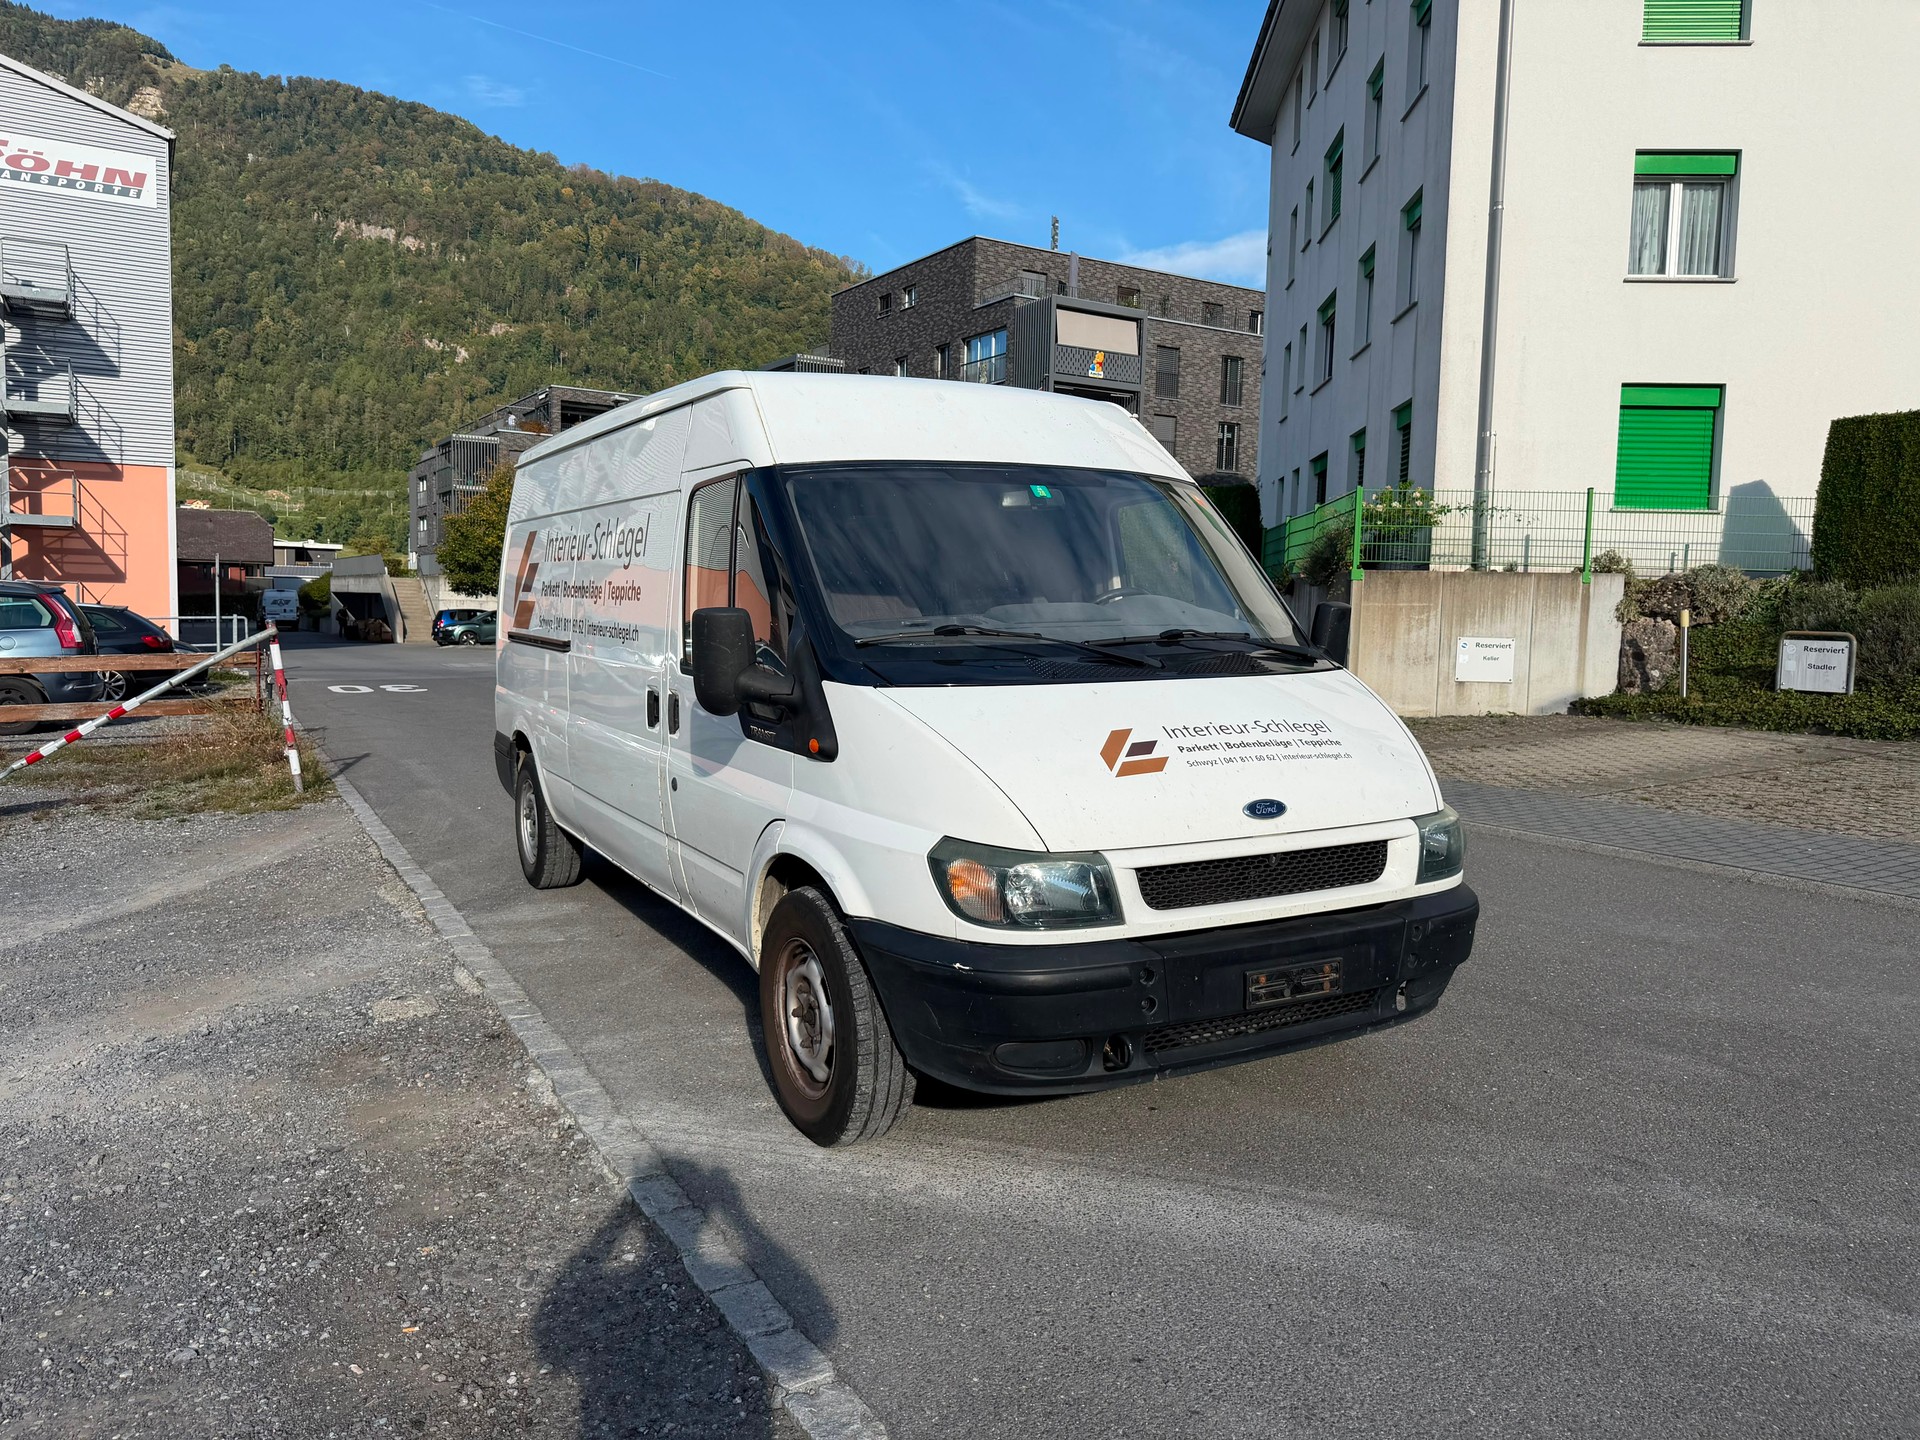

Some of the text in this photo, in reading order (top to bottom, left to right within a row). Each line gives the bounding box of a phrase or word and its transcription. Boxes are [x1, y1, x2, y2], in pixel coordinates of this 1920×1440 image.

[544, 513, 651, 570] Interieur-Schlegel
[541, 579, 642, 606] Parkett Bodenbeläge Teppiche
[587, 619, 639, 645] interieur-schlegel.ch
[1475, 642, 1512, 650] Reserviert
[1803, 645, 1845, 654] Reserviert
[1807, 662, 1837, 671] Stadler
[1162, 719, 1332, 739] Interieur-Schlegel
[1177, 738, 1342, 754] Parkett Bodenbeläge Teppiche
[1186, 752, 1353, 768] Schwyz 041 811 60 62 interieur-schlegel.ch
